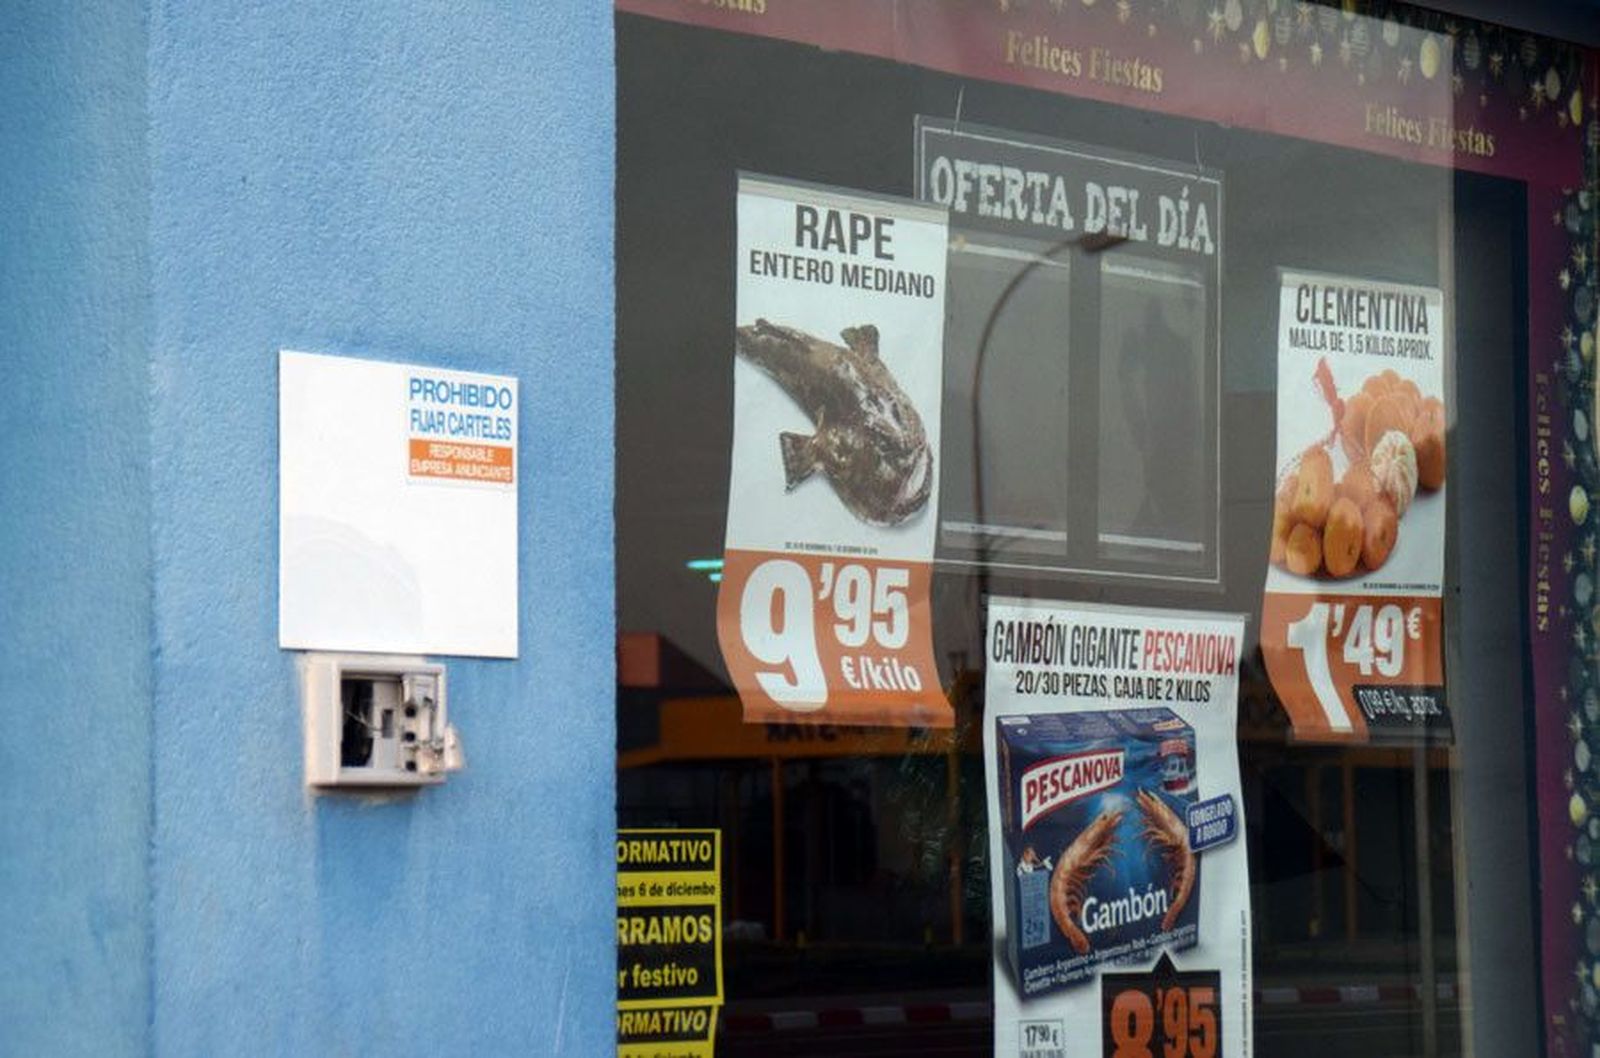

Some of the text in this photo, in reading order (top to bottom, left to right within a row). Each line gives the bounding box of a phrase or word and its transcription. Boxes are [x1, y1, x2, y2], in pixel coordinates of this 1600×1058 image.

[1002, 30, 1164, 94] Felices Fiestas
[1365, 101, 1495, 157] Felices Fiestas
[930, 156, 1214, 254] OFERTA DEL DÍA
[796, 204, 894, 261] RAPE
[750, 249, 935, 299] ENTERO MEDIANO
[1296, 284, 1429, 334] CLEMENTINA
[1289, 327, 1327, 350] MALLA
[1330, 331, 1345, 352] DE
[1365, 335, 1395, 357] KILOS
[409, 378, 513, 410] PROHIBIDO
[410, 408, 512, 441] FIJAR CARTELES
[740, 559, 909, 712] 9'95
[992, 615, 1236, 676] GAMBÓN GIGANTE PESCANOVA
[840, 655, 922, 692] €/kilo
[1016, 670, 1211, 702] 20/30 PIEZAS, CAJA DE 2 KILOS
[1026, 756, 1121, 814] PESCANOVA
[638, 882, 646, 897] 6
[649, 882, 663, 897] de
[1082, 884, 1167, 933] Gambón
[632, 963, 698, 988] festivo
[617, 1009, 707, 1034] RMATIVO
